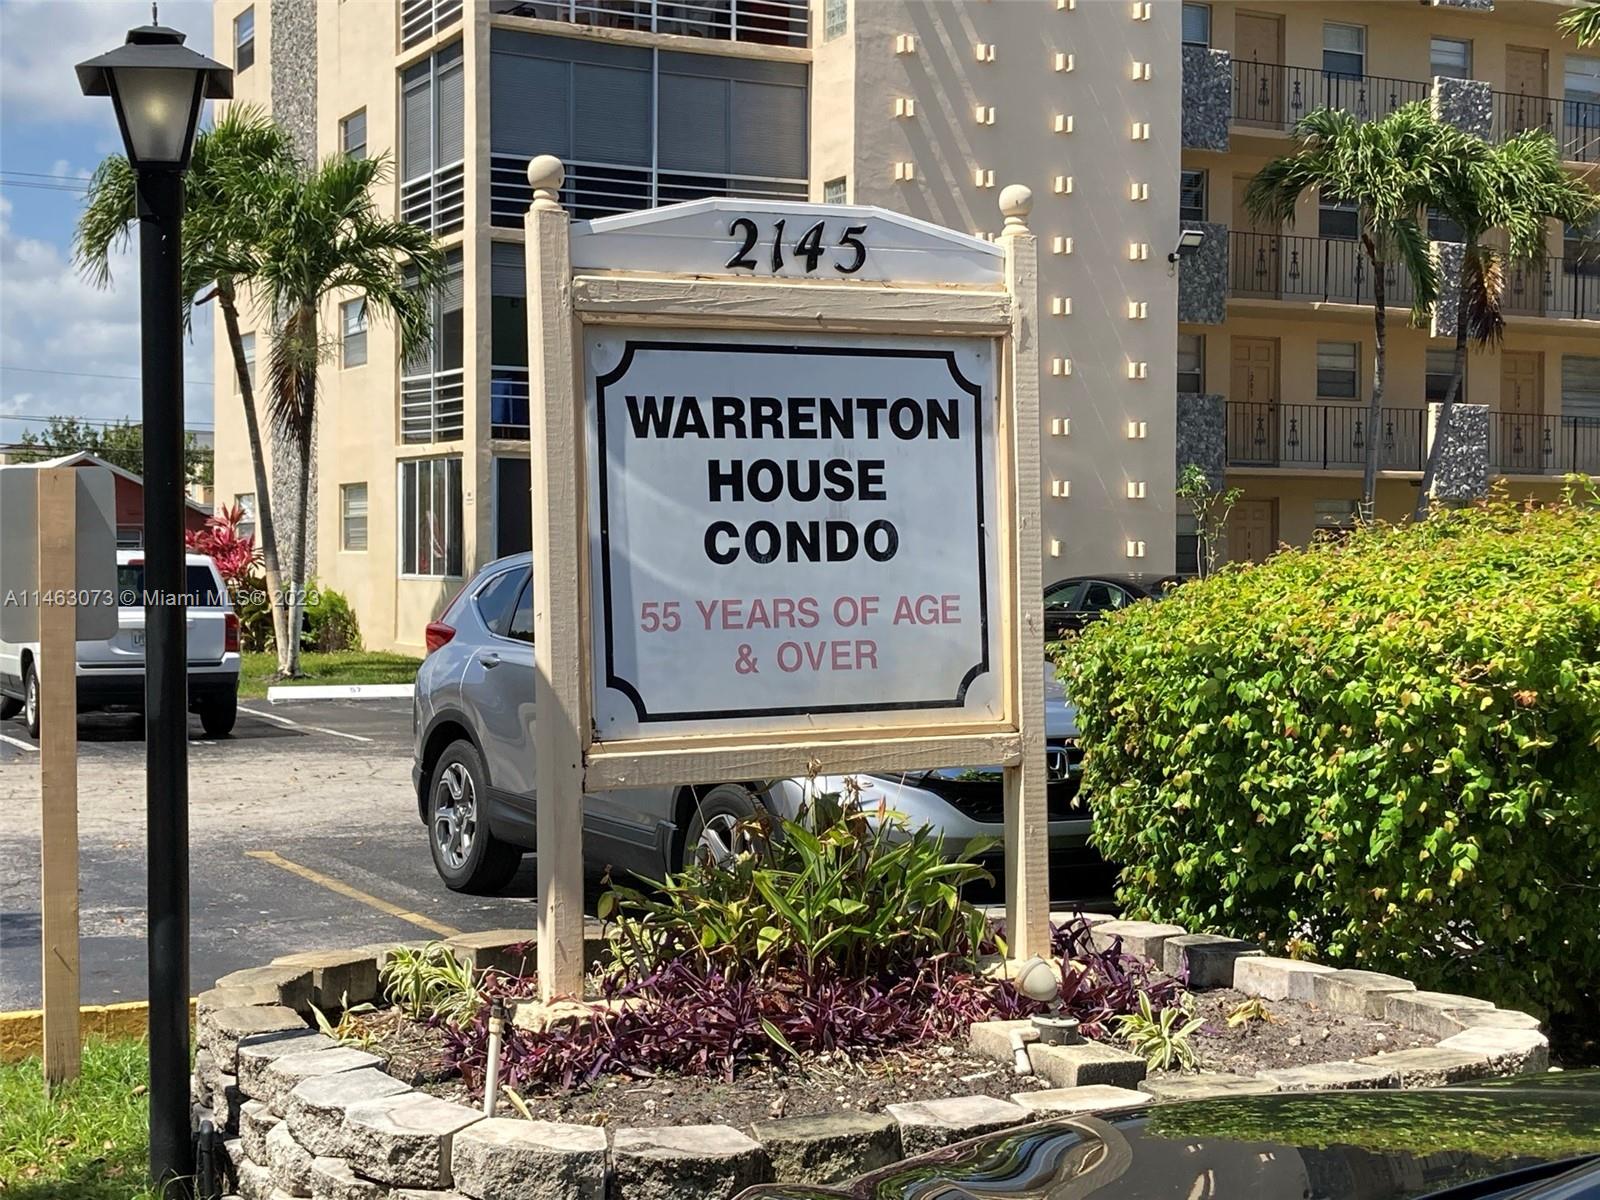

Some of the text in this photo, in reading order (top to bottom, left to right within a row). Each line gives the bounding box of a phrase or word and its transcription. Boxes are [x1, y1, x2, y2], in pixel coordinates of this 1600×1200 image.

[725, 217, 867, 274] 2145
[624, 395, 960, 440] WARRENTON
[707, 459, 887, 502] HOUSE
[703, 520, 899, 565] CONDO
[641, 595, 962, 632] 55 YEARS OF AGE
[735, 640, 879, 674] & OVER
